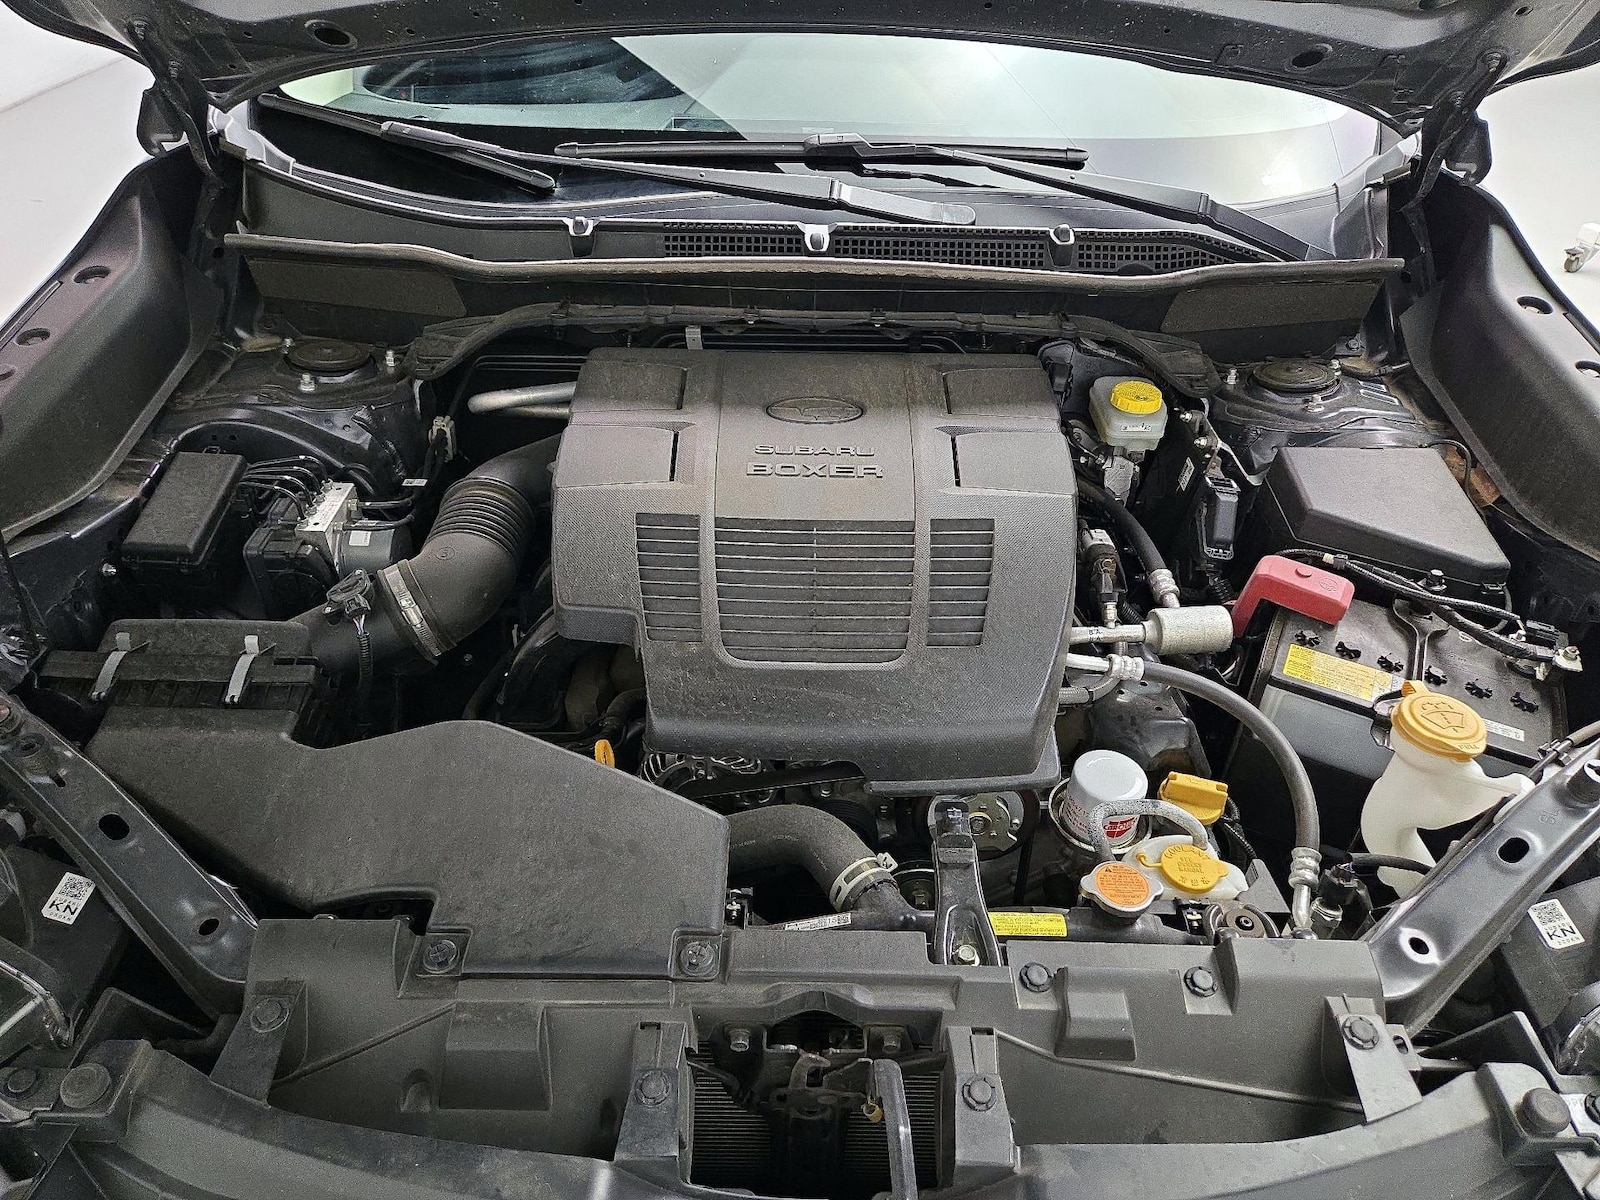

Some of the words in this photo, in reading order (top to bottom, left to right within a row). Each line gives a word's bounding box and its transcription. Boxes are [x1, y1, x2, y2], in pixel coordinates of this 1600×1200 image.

[755, 444, 875, 457] SUBARU
[746, 462, 883, 478] BOXER
[49, 900, 79, 916] KN
[1547, 926, 1576, 941] KN
